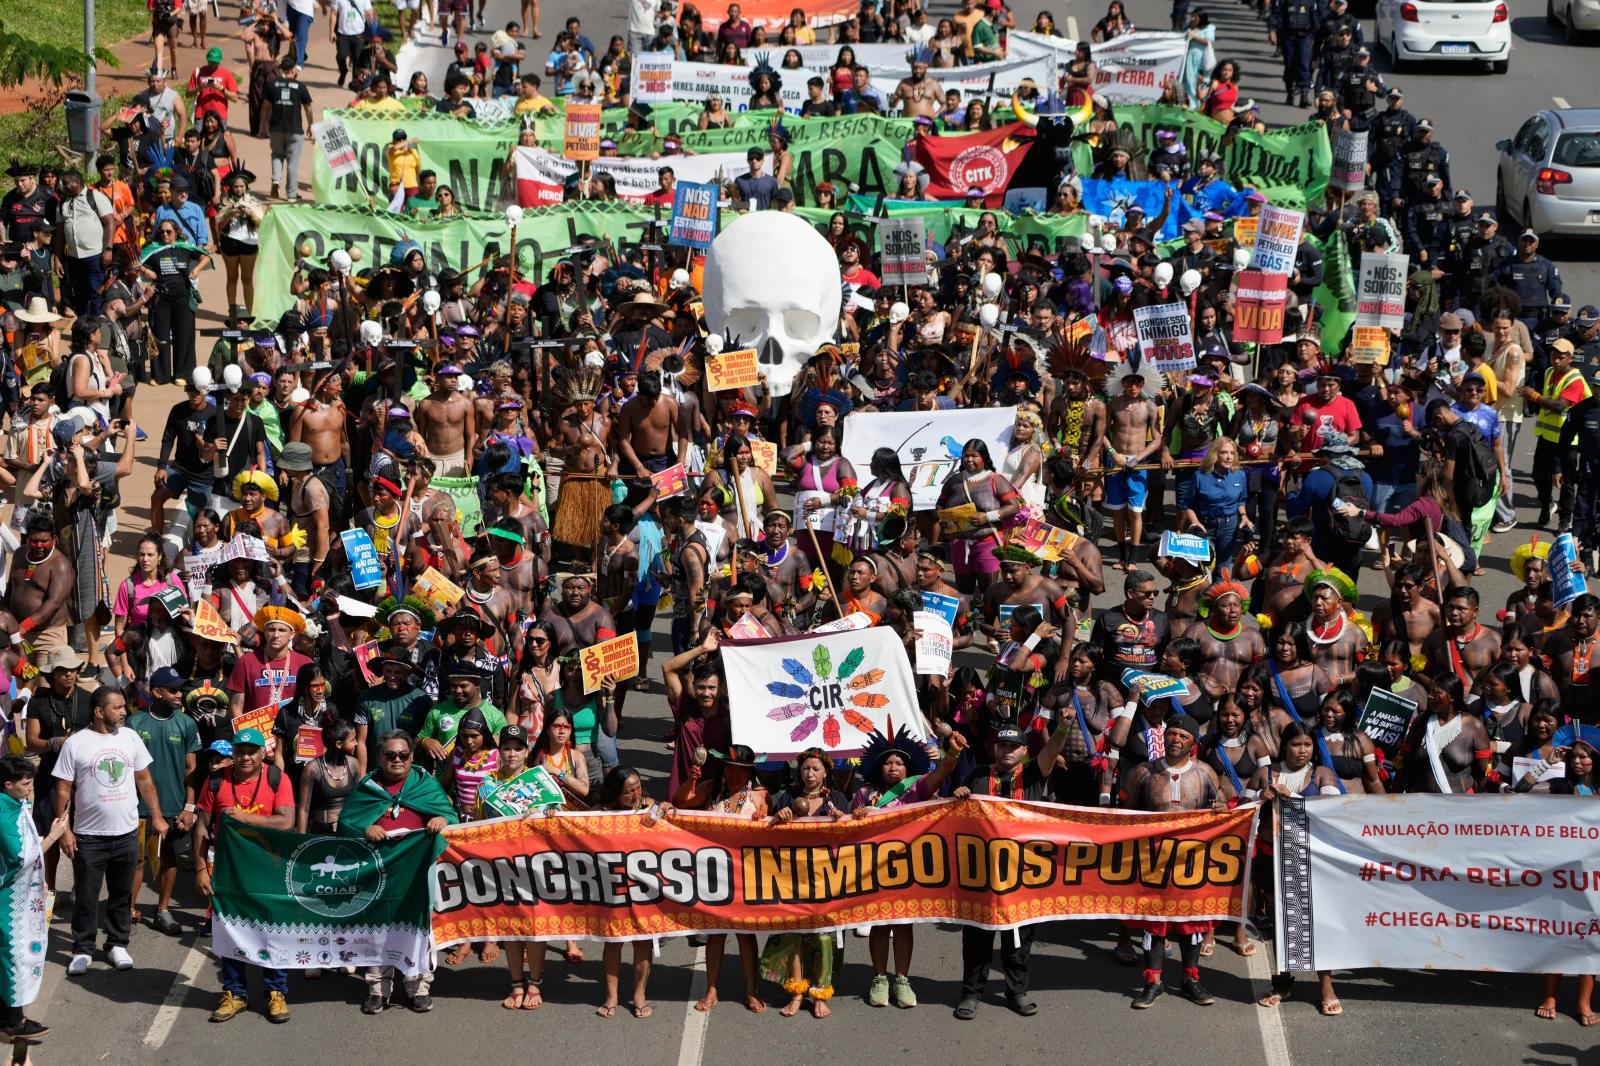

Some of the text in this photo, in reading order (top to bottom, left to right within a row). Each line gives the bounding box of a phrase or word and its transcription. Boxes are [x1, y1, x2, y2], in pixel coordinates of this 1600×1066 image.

[1117, 70, 1154, 87] TERRA
[568, 123, 597, 137] LIVRE
[1338, 138, 1367, 152] NOSSO
[1335, 147, 1366, 163] FUTURO
[965, 166, 992, 183] CITK
[686, 187, 711, 206] NÓS
[674, 216, 714, 232] ESTAMOS
[681, 228, 711, 243] VENDA
[892, 227, 913, 243] NÓS
[885, 242, 921, 256] SOMOS
[1259, 252, 1282, 271] GÁS
[1373, 264, 1398, 282] NÓS
[1363, 280, 1402, 297] SOMOS
[1359, 301, 1404, 316] NATUREZA
[1138, 315, 1187, 329] CONGRESSO
[1236, 305, 1282, 331] VIDA
[1140, 323, 1188, 341] INIMIGO
[1144, 343, 1193, 364] POVOS
[1177, 539, 1205, 549] MORTE
[601, 636, 634, 655] SEM POVOS
[1148, 679, 1178, 691] VIDA
[809, 683, 844, 711] CIR
[1370, 710, 1376, 718] A
[1365, 717, 1405, 733] NÃO SUPORTA
[1364, 725, 1400, 748] MAIS!
[1361, 820, 1599, 840] ANULAÇÃO IMEDIATA DE BELO
[432, 833, 1244, 914] CONGRESSO INIMIGO DOS POVOS
[1358, 862, 1459, 883] #FORA
[1467, 867, 1543, 888] BELO
[315, 885, 358, 895] COIAB
[1364, 912, 1450, 929] #CHEGA
[1455, 914, 1481, 930] DE
